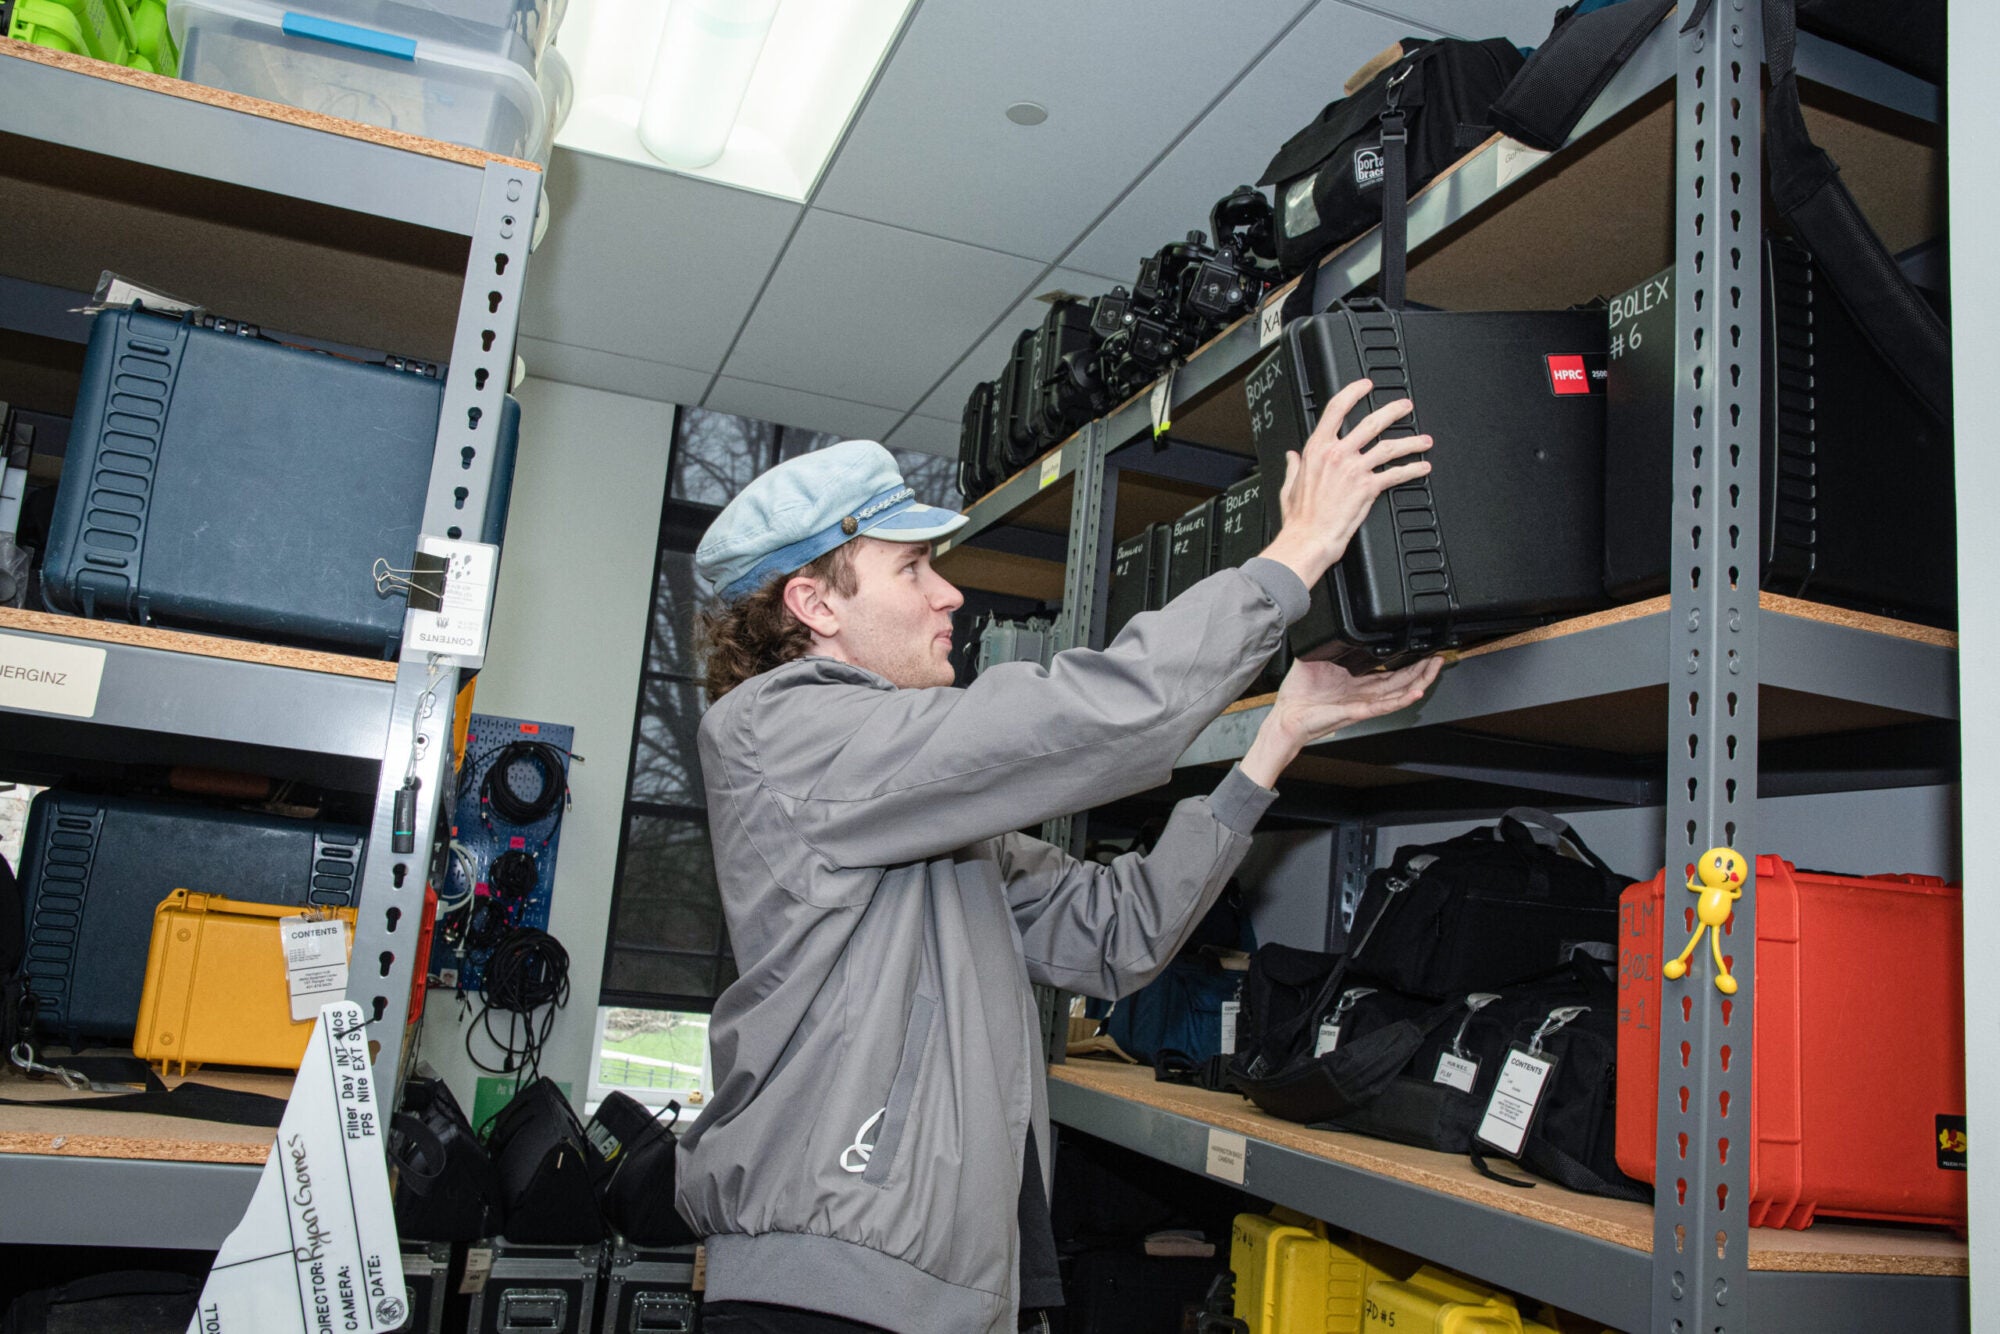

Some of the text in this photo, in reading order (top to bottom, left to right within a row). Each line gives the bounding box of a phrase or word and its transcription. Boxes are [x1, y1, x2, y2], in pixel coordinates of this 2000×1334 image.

[1609, 276, 1669, 330] BOLEX
[1246, 360, 1283, 410] BOLEX
[1553, 369, 1584, 380] HPRC
[1225, 486, 1260, 513] BOLEX
[1224, 513, 1244, 534] #1
[1174, 539, 1189, 555] #2
[420, 633, 474, 647] CONTENTS
[291, 926, 338, 940] CONTENTS
[335, 1046, 350, 1066] INT
[1511, 1058, 1544, 1075] CONTENTS
[342, 1075, 354, 1099] Day
[347, 1010, 375, 1136] FPS Nite EXT Sync
[347, 1107, 361, 1139] Filter
[295, 1207, 332, 1263] Ryan
[367, 1255, 385, 1297] DATE:
[311, 1262, 333, 1334] DIRECTOR:
[338, 1266, 358, 1331] CAMERA:
[204, 1303, 220, 1334] OLL
